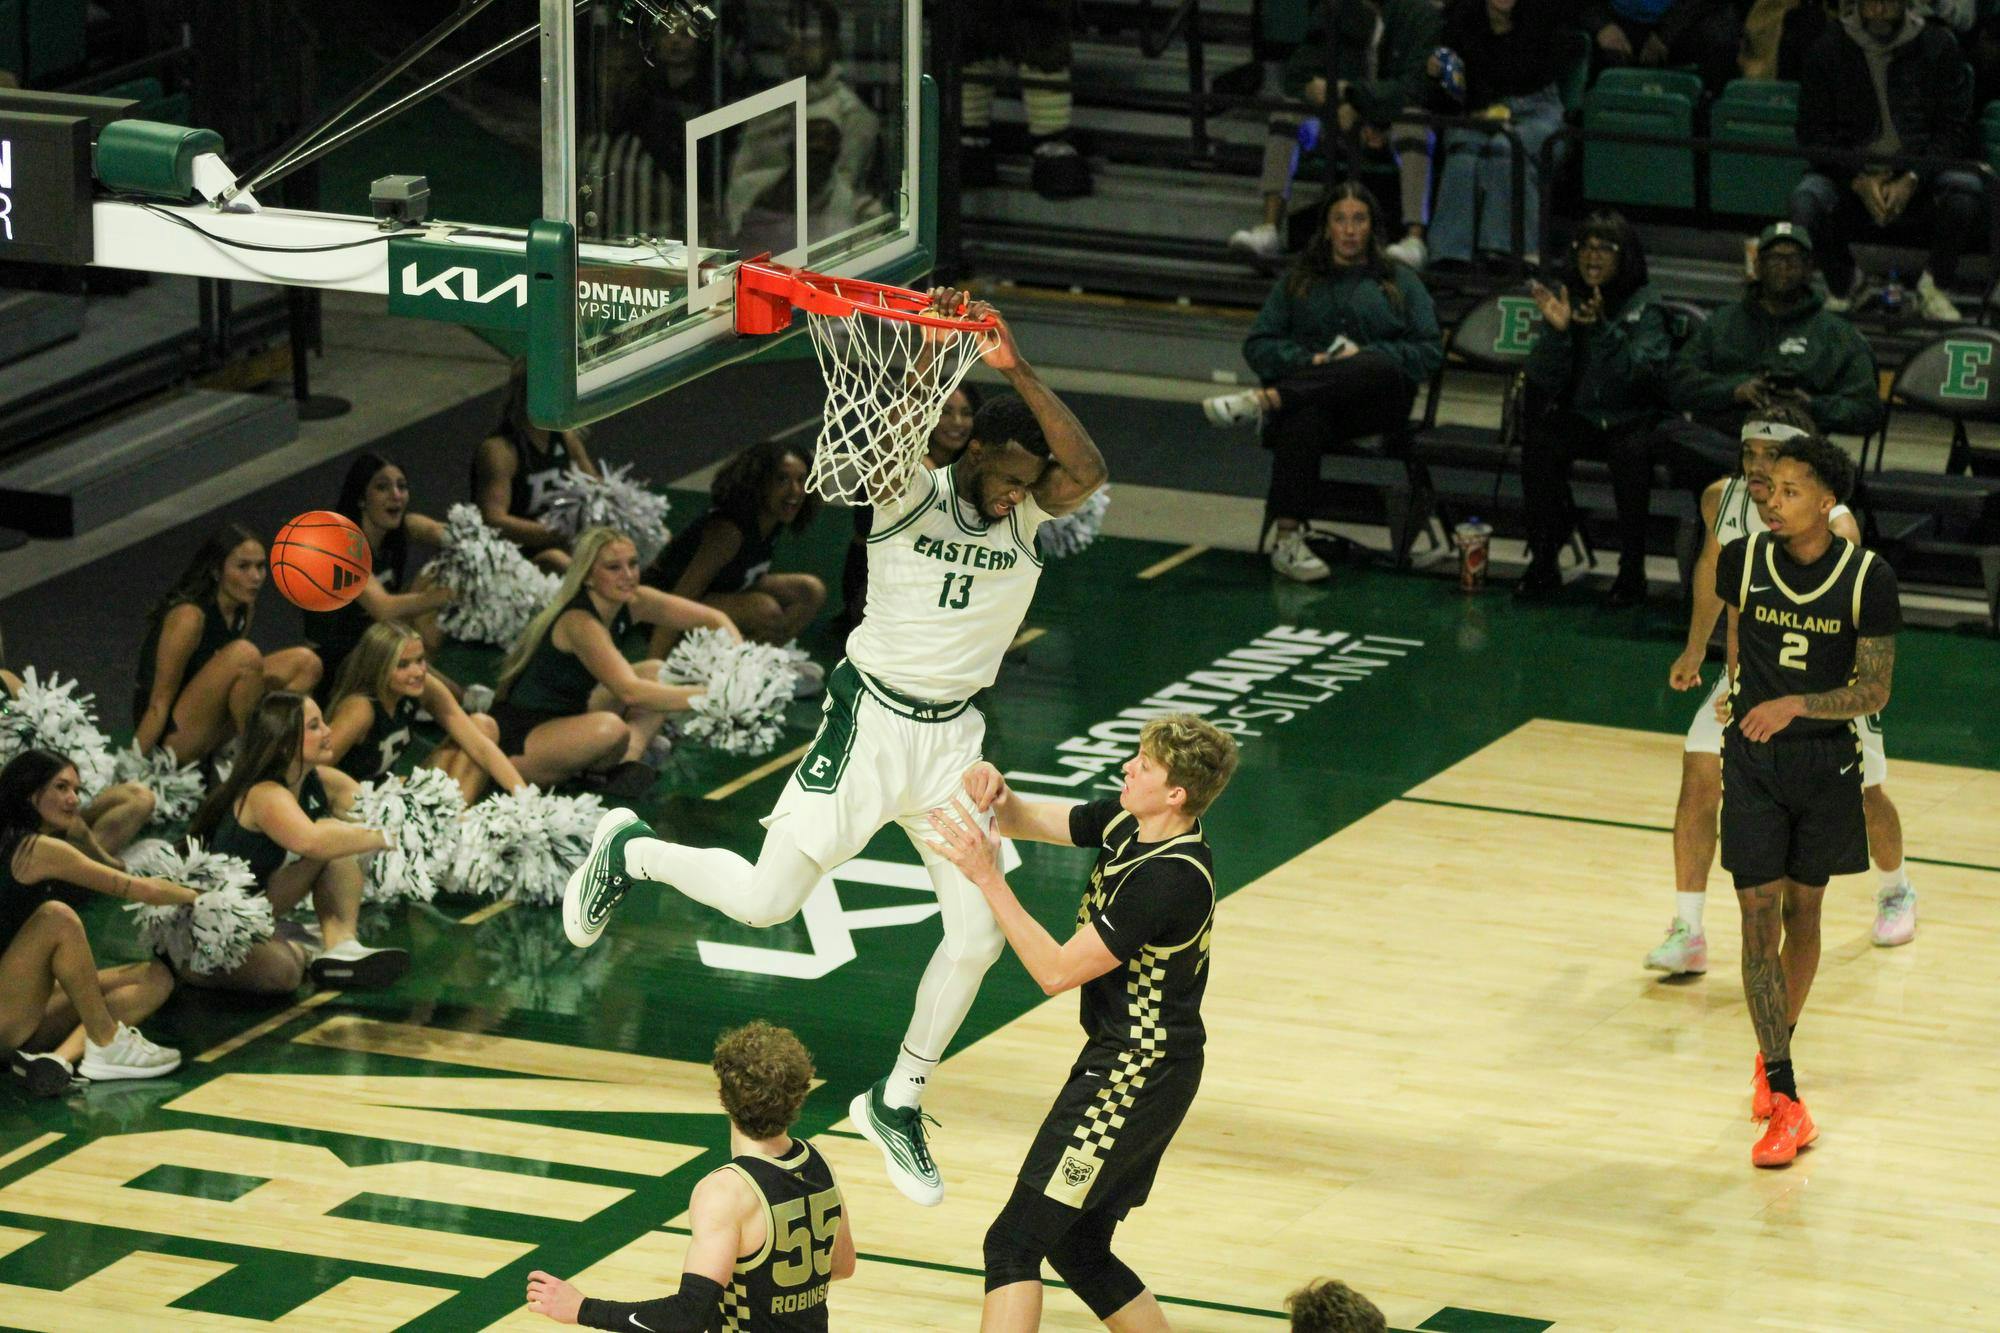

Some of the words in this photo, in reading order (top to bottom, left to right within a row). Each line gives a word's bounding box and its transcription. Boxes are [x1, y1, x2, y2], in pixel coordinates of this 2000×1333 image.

[1940, 340, 1992, 400] E
[913, 534, 1018, 570] EASTERN
[938, 572, 975, 609] 13
[1755, 605, 1841, 634] OAKLAND
[1779, 632, 1809, 671] 2
[1211, 635, 1425, 747] PSILANTI
[808, 754, 832, 779] E
[771, 1186, 841, 1288] 55
